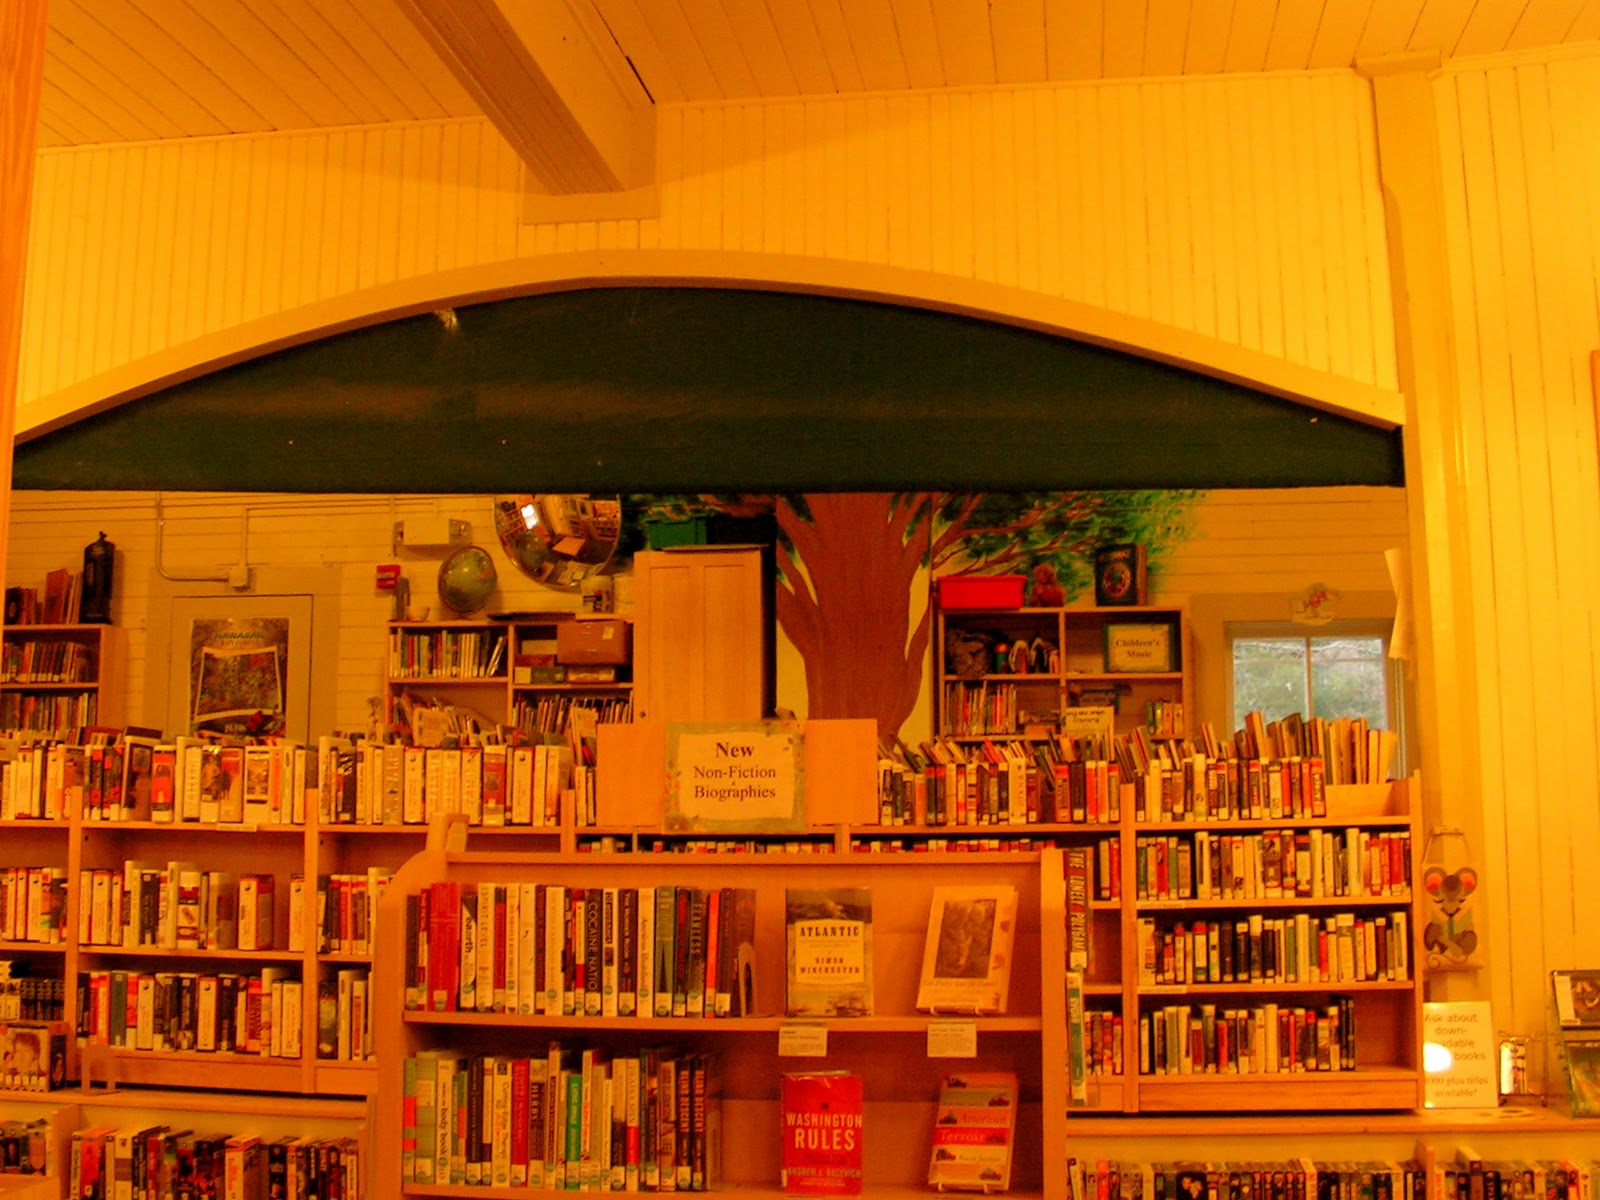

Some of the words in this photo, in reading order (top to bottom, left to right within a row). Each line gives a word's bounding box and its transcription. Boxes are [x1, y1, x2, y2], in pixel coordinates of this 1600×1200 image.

[1115, 639, 1160, 648] Children's
[1126, 650, 1152, 658] Music
[715, 742, 755, 758] New
[693, 765, 776, 779] Non-Fiction
[693, 785, 776, 801] Biographies
[1070, 852, 1085, 869] THE
[1070, 875, 1086, 906] LONELY
[588, 902, 598, 954] COCAINE
[799, 926, 860, 937] ATLANTIC
[1070, 911, 1087, 952] POLYGAM
[814, 956, 845, 965] SIMON
[588, 956, 598, 992] NATIO
[799, 966, 861, 974] WINCHESTER
[1424, 1014, 1443, 1022] Ask
[1446, 1013, 1478, 1023] about
[1434, 1027, 1468, 1035] down-
[1453, 1052, 1487, 1061] books
[1446, 1076, 1465, 1086] plus
[1466, 1075, 1489, 1085] titles
[1434, 1088, 1478, 1097] available!
[439, 1108, 448, 1131] body
[680, 1096, 690, 1133] DESCENT
[695, 1096, 705, 1133] DESCENT
[785, 1112, 863, 1128] WASHINGTON
[440, 1133, 448, 1155] book
[500, 1132, 509, 1159] Therapi
[794, 1128, 856, 1151] RULES
